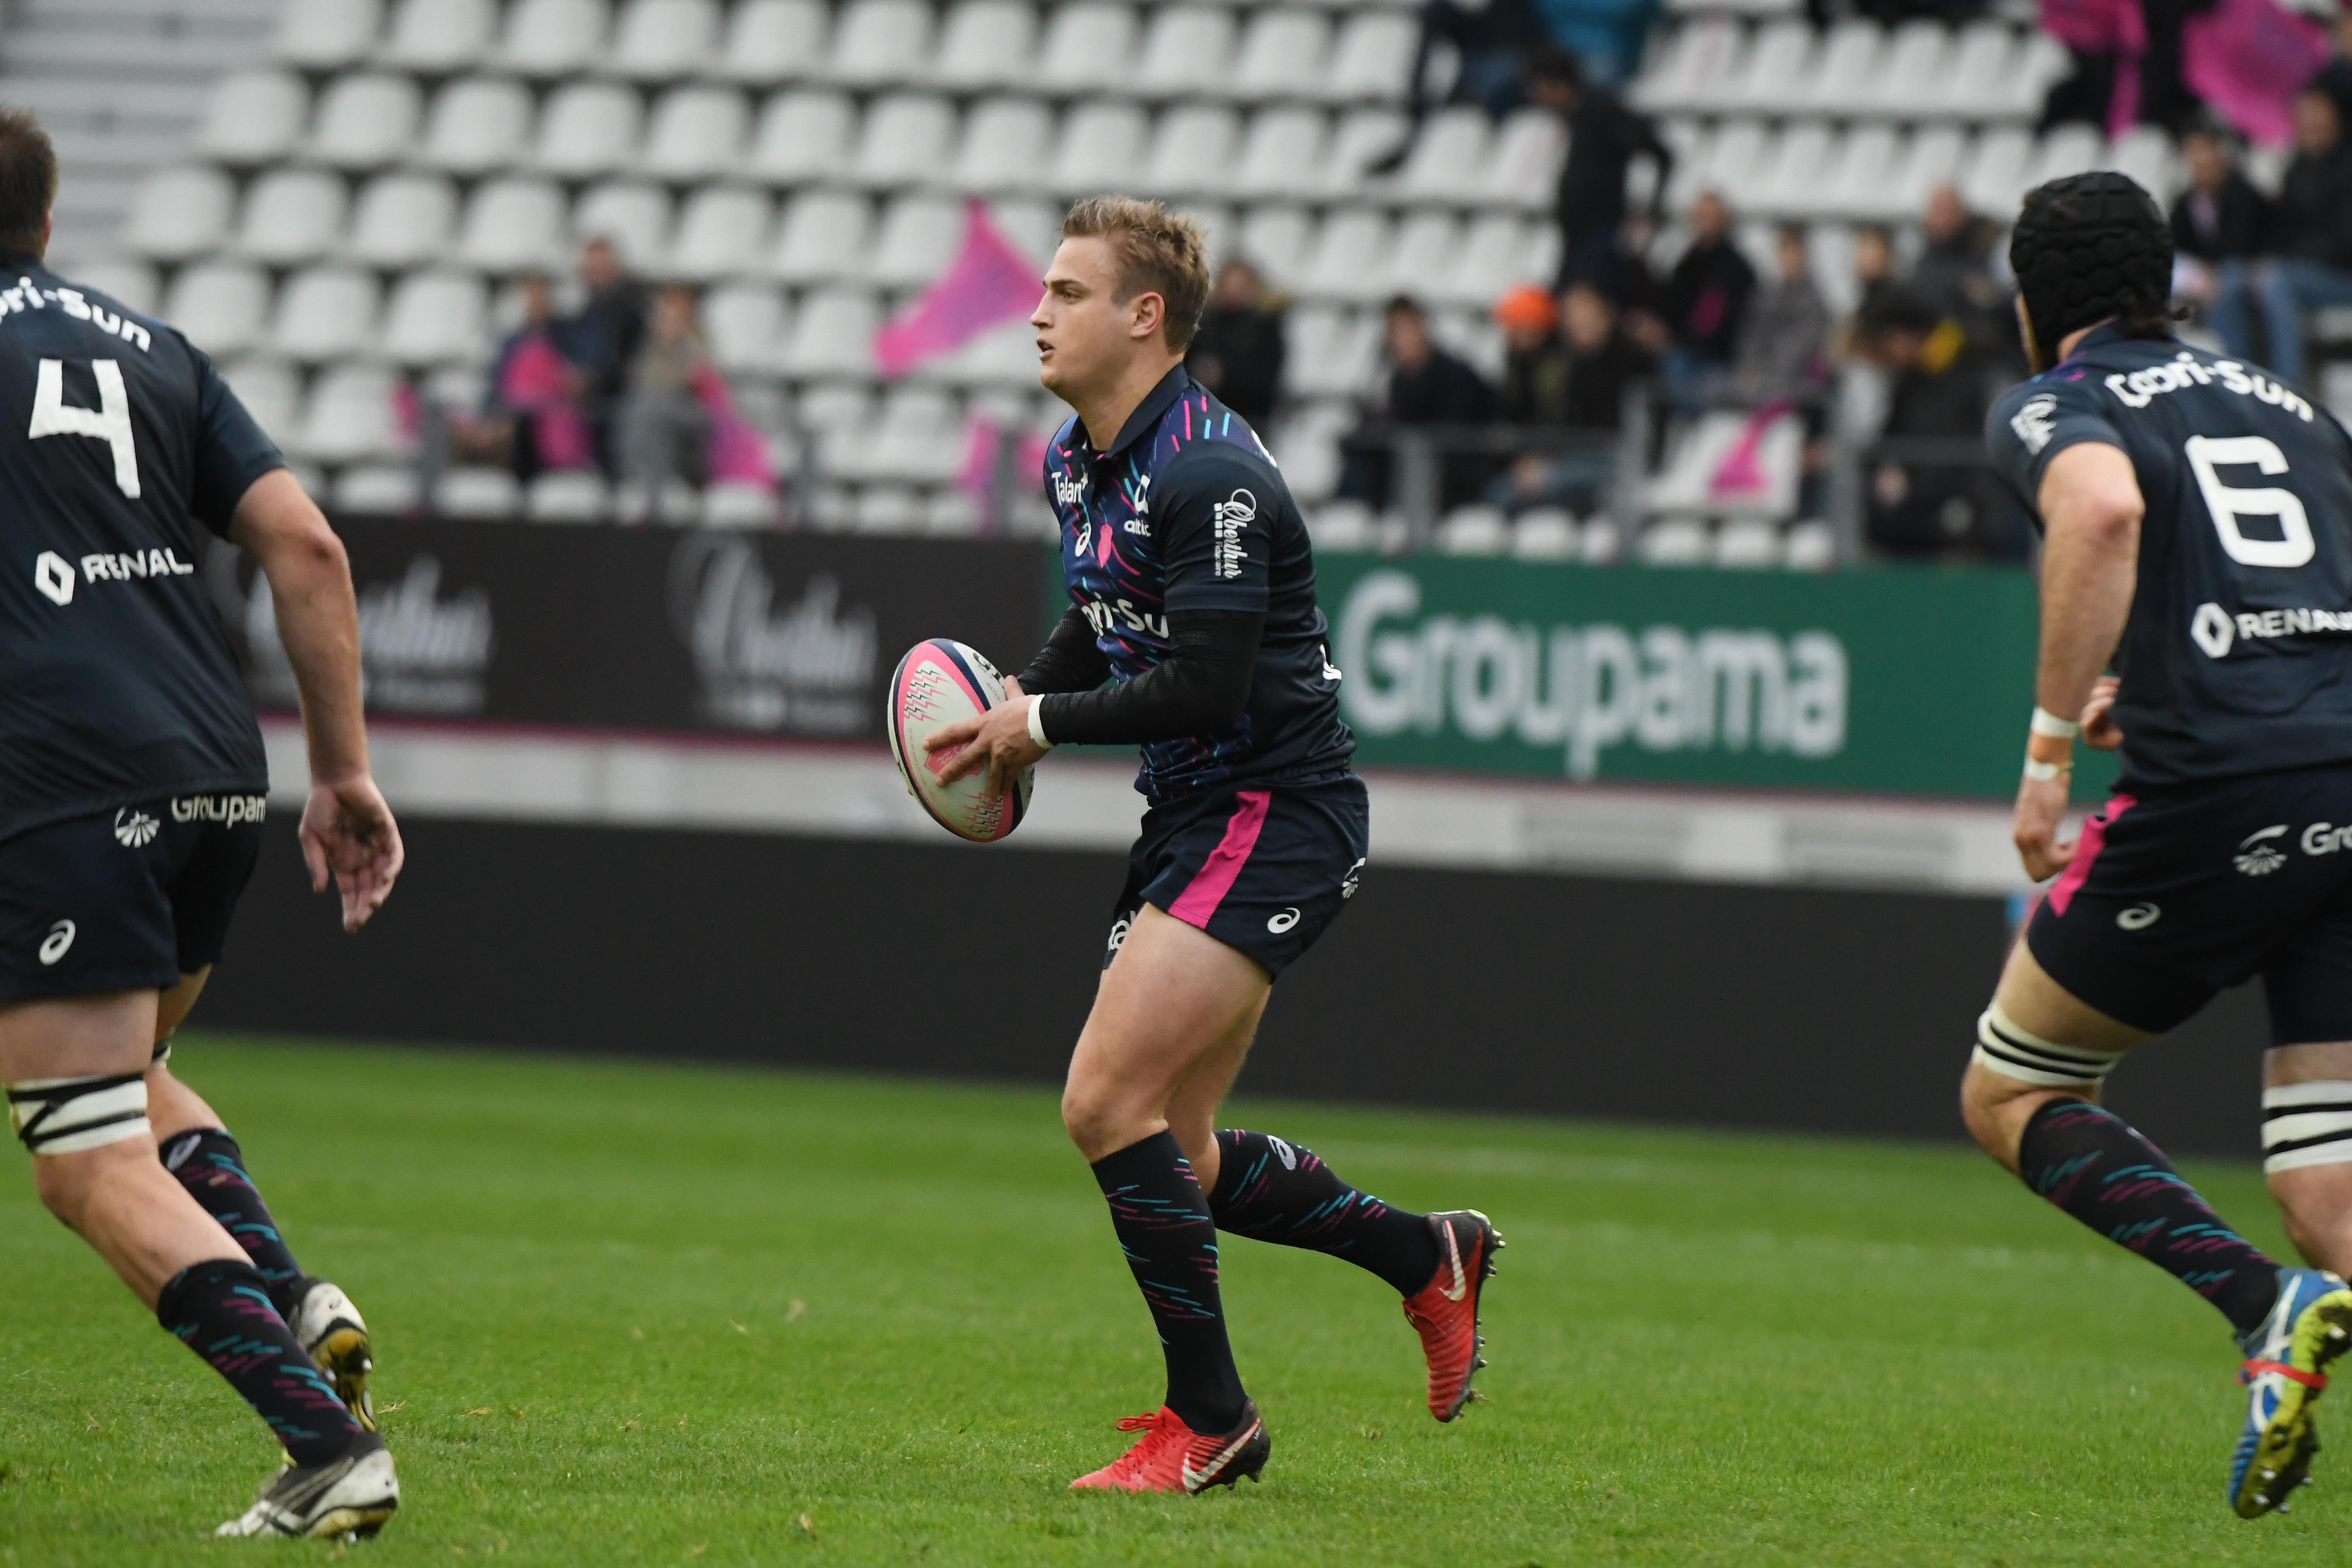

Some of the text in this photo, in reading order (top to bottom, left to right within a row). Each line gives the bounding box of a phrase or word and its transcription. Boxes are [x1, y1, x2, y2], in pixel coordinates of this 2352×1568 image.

[29, 359, 141, 499] 4
[2185, 435, 2315, 568] 6
[1335, 569, 1848, 781] Groupama
